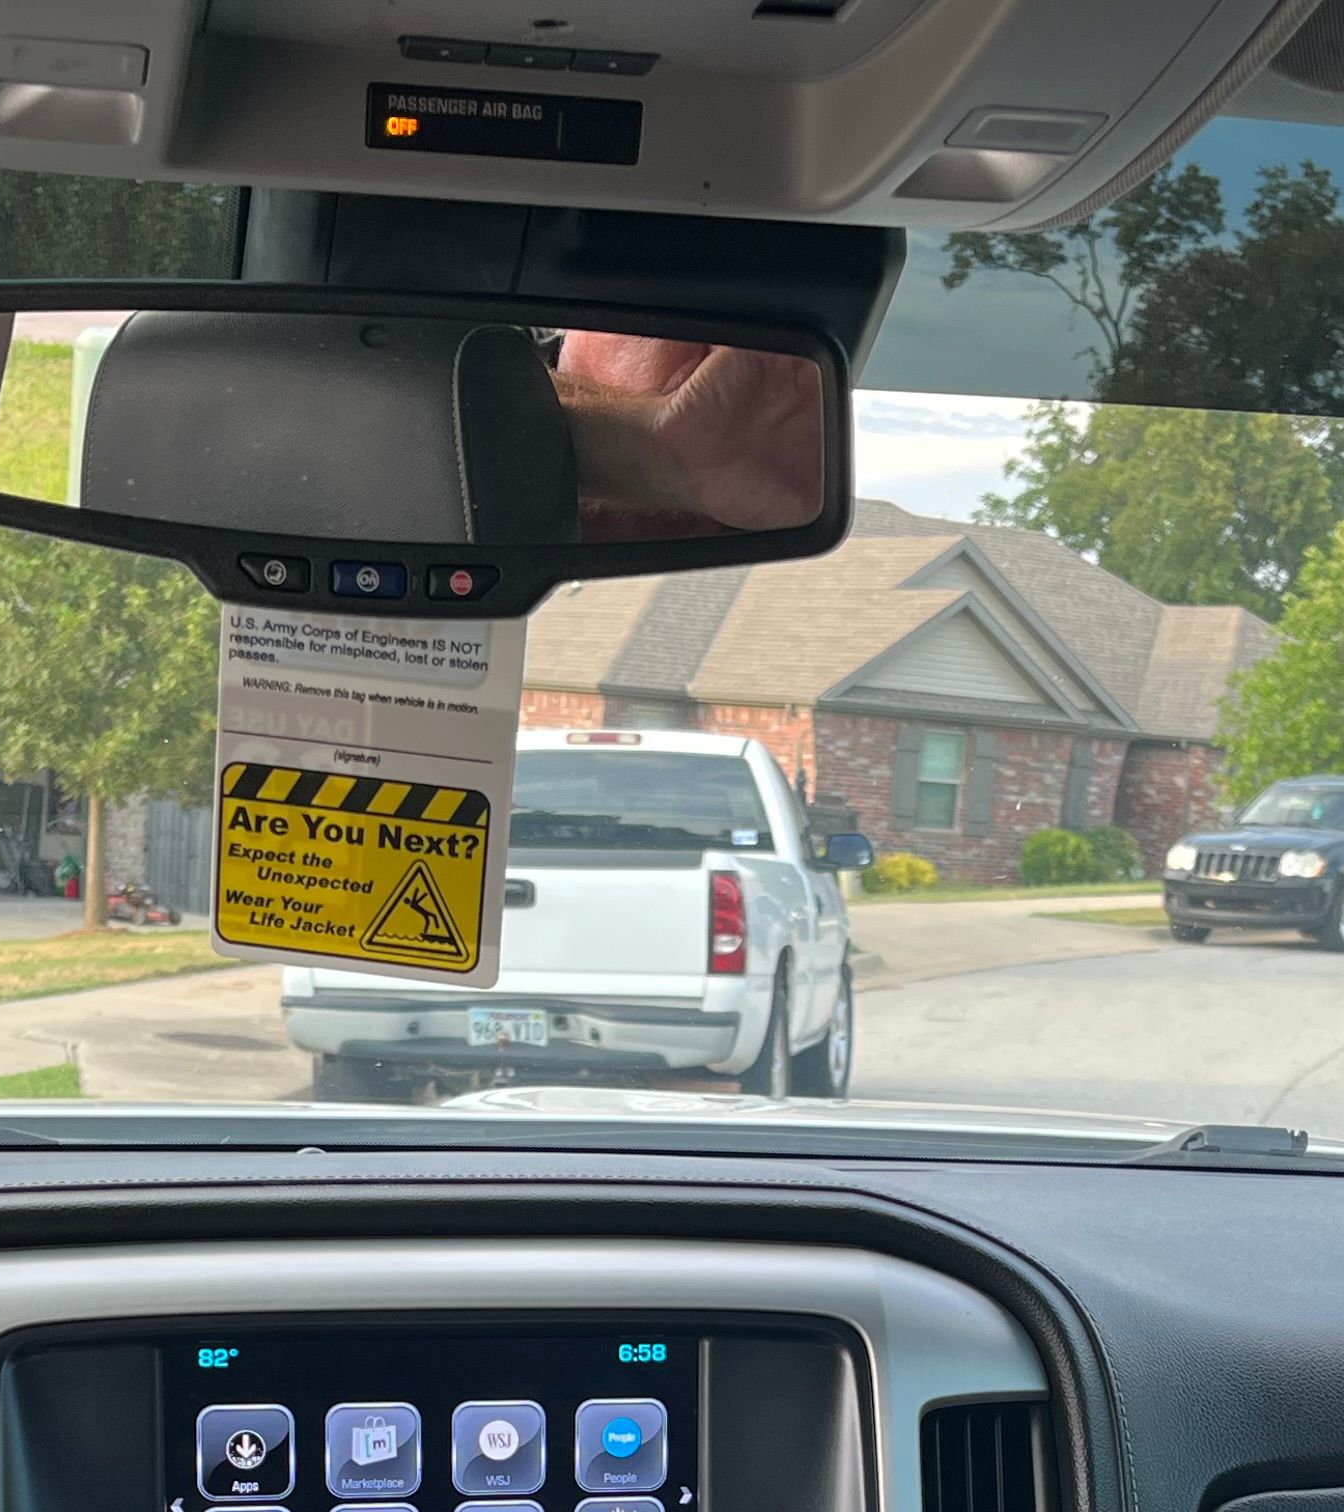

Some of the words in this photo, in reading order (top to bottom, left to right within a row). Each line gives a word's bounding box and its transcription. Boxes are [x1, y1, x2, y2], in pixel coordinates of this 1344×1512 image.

[388, 94, 477, 115] PASSENGER
[482, 102, 508, 118] AIR
[512, 103, 542, 120] BAG
[387, 116, 418, 136] OFF
[230, 616, 258, 631] U.S.
[263, 620, 297, 637] Army
[302, 624, 341, 642] Corps
[345, 630, 359, 642] of
[362, 630, 428, 649] Engineers
[433, 639, 446, 652] IS
[450, 641, 482, 656] NOT
[229, 648, 279, 664] passes.
[230, 634, 305, 652] responsible
[309, 640, 327, 652] for
[330, 644, 400, 664] misplaced,
[405, 652, 428, 665] lost
[431, 657, 446, 667] or
[449, 657, 488, 671] stolen
[243, 677, 292, 692] WARNING:
[295, 682, 331, 697] Remove
[334, 688, 349, 699] this
[352, 690, 365, 703] tag
[368, 692, 391, 704] when
[394, 696, 424, 708] vehicle
[427, 699, 434, 710] is
[437, 700, 445, 710] in
[228, 806, 288, 836] Are
[302, 813, 364, 845] You
[378, 824, 479, 860] Next?
[228, 843, 295, 864] Expect
[302, 852, 333, 869] the
[257, 866, 374, 894] Unexpected
[225, 889, 274, 909] Wear
[281, 896, 323, 914] Your
[250, 912, 285, 929] Life
[290, 917, 356, 937] Jacket
[198, 1348, 239, 1368] 82°
[618, 1343, 668, 1363] 6:58
[487, 1433, 512, 1449] WSJ
[608, 1429, 636, 1443] People
[232, 1480, 259, 1493] Apps
[342, 1477, 405, 1491] Marketplace
[486, 1475, 511, 1487] WSJ
[604, 1472, 638, 1485] People
